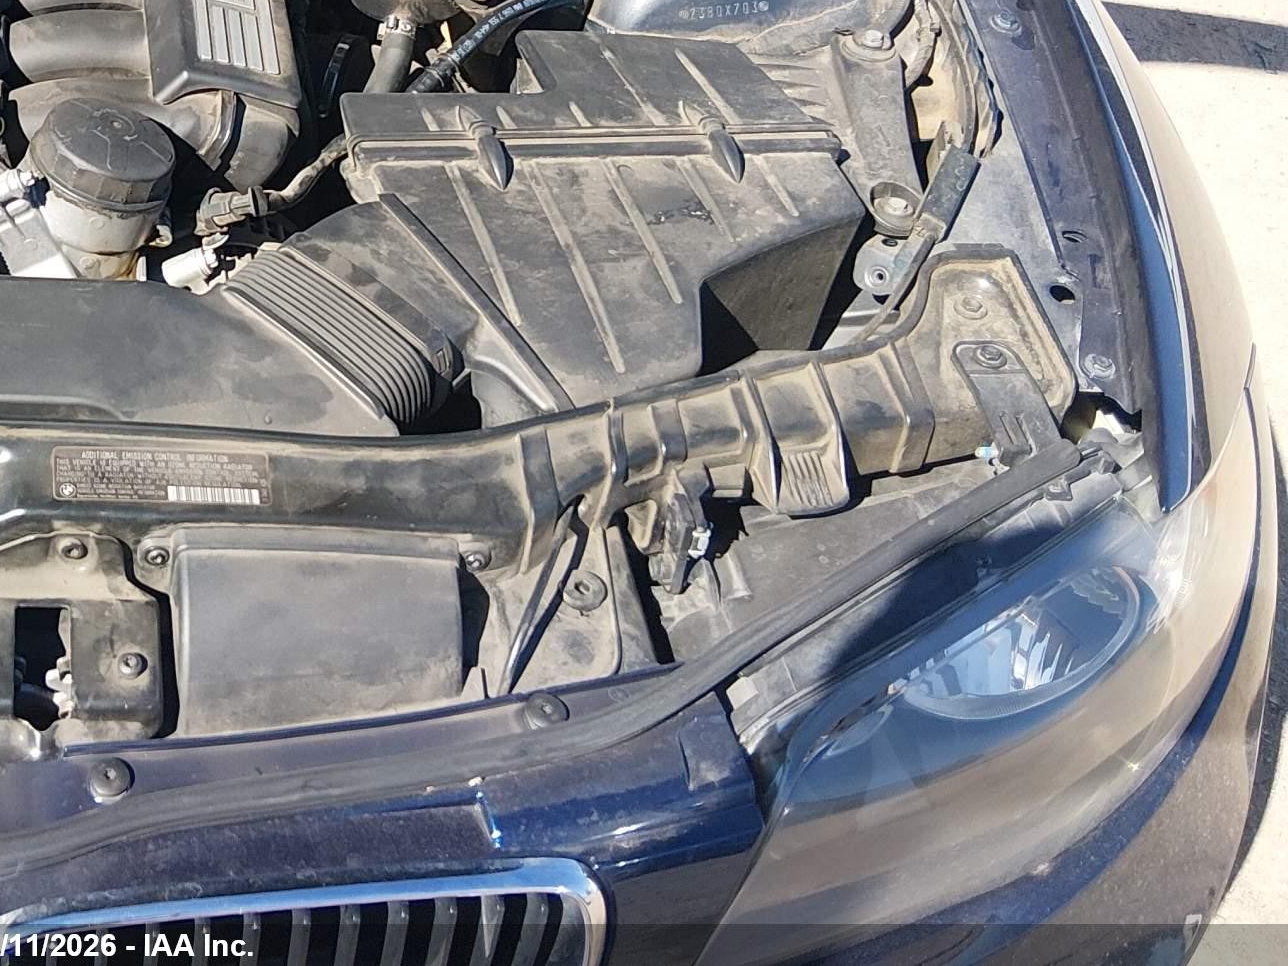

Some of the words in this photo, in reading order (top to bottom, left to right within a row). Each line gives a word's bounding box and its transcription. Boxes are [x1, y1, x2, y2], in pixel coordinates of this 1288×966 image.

[81, 450, 117, 459] ADDITIONAL
[121, 451, 153, 460] EMISSION
[154, 452, 182, 462] CONTROL
